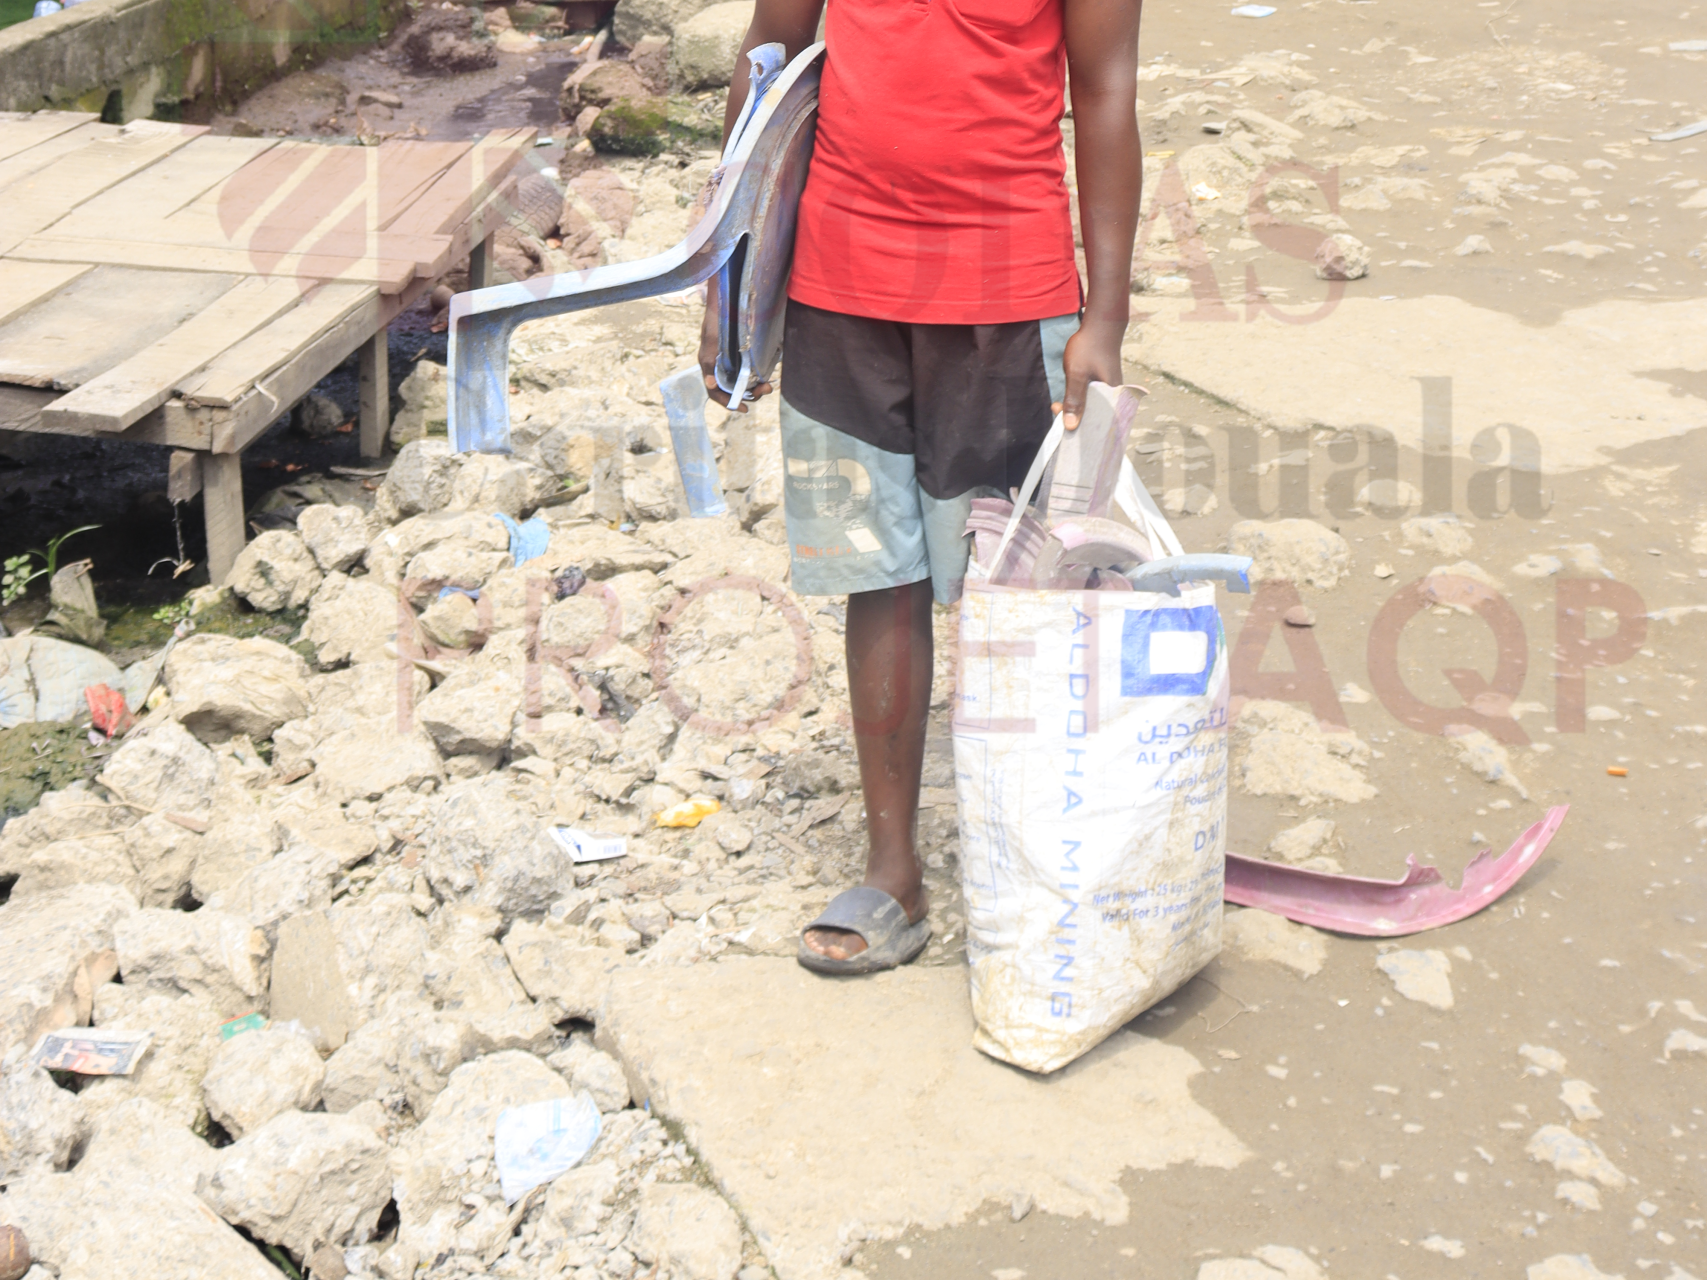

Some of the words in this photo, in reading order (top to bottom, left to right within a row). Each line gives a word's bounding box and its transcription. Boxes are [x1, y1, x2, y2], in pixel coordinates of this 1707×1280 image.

[1136, 751, 1161, 765] AL
[1154, 772, 1198, 792] Natural
[1092, 893, 1111, 908] Net
[1113, 886, 1148, 904] Weight
[1156, 883, 1169, 897] 25
[1101, 908, 1130, 924] Valid
[1132, 906, 1151, 921] For
[1153, 905, 1161, 918] 3
[1162, 901, 1189, 920] years
[1050, 839, 1083, 1018] MINING
